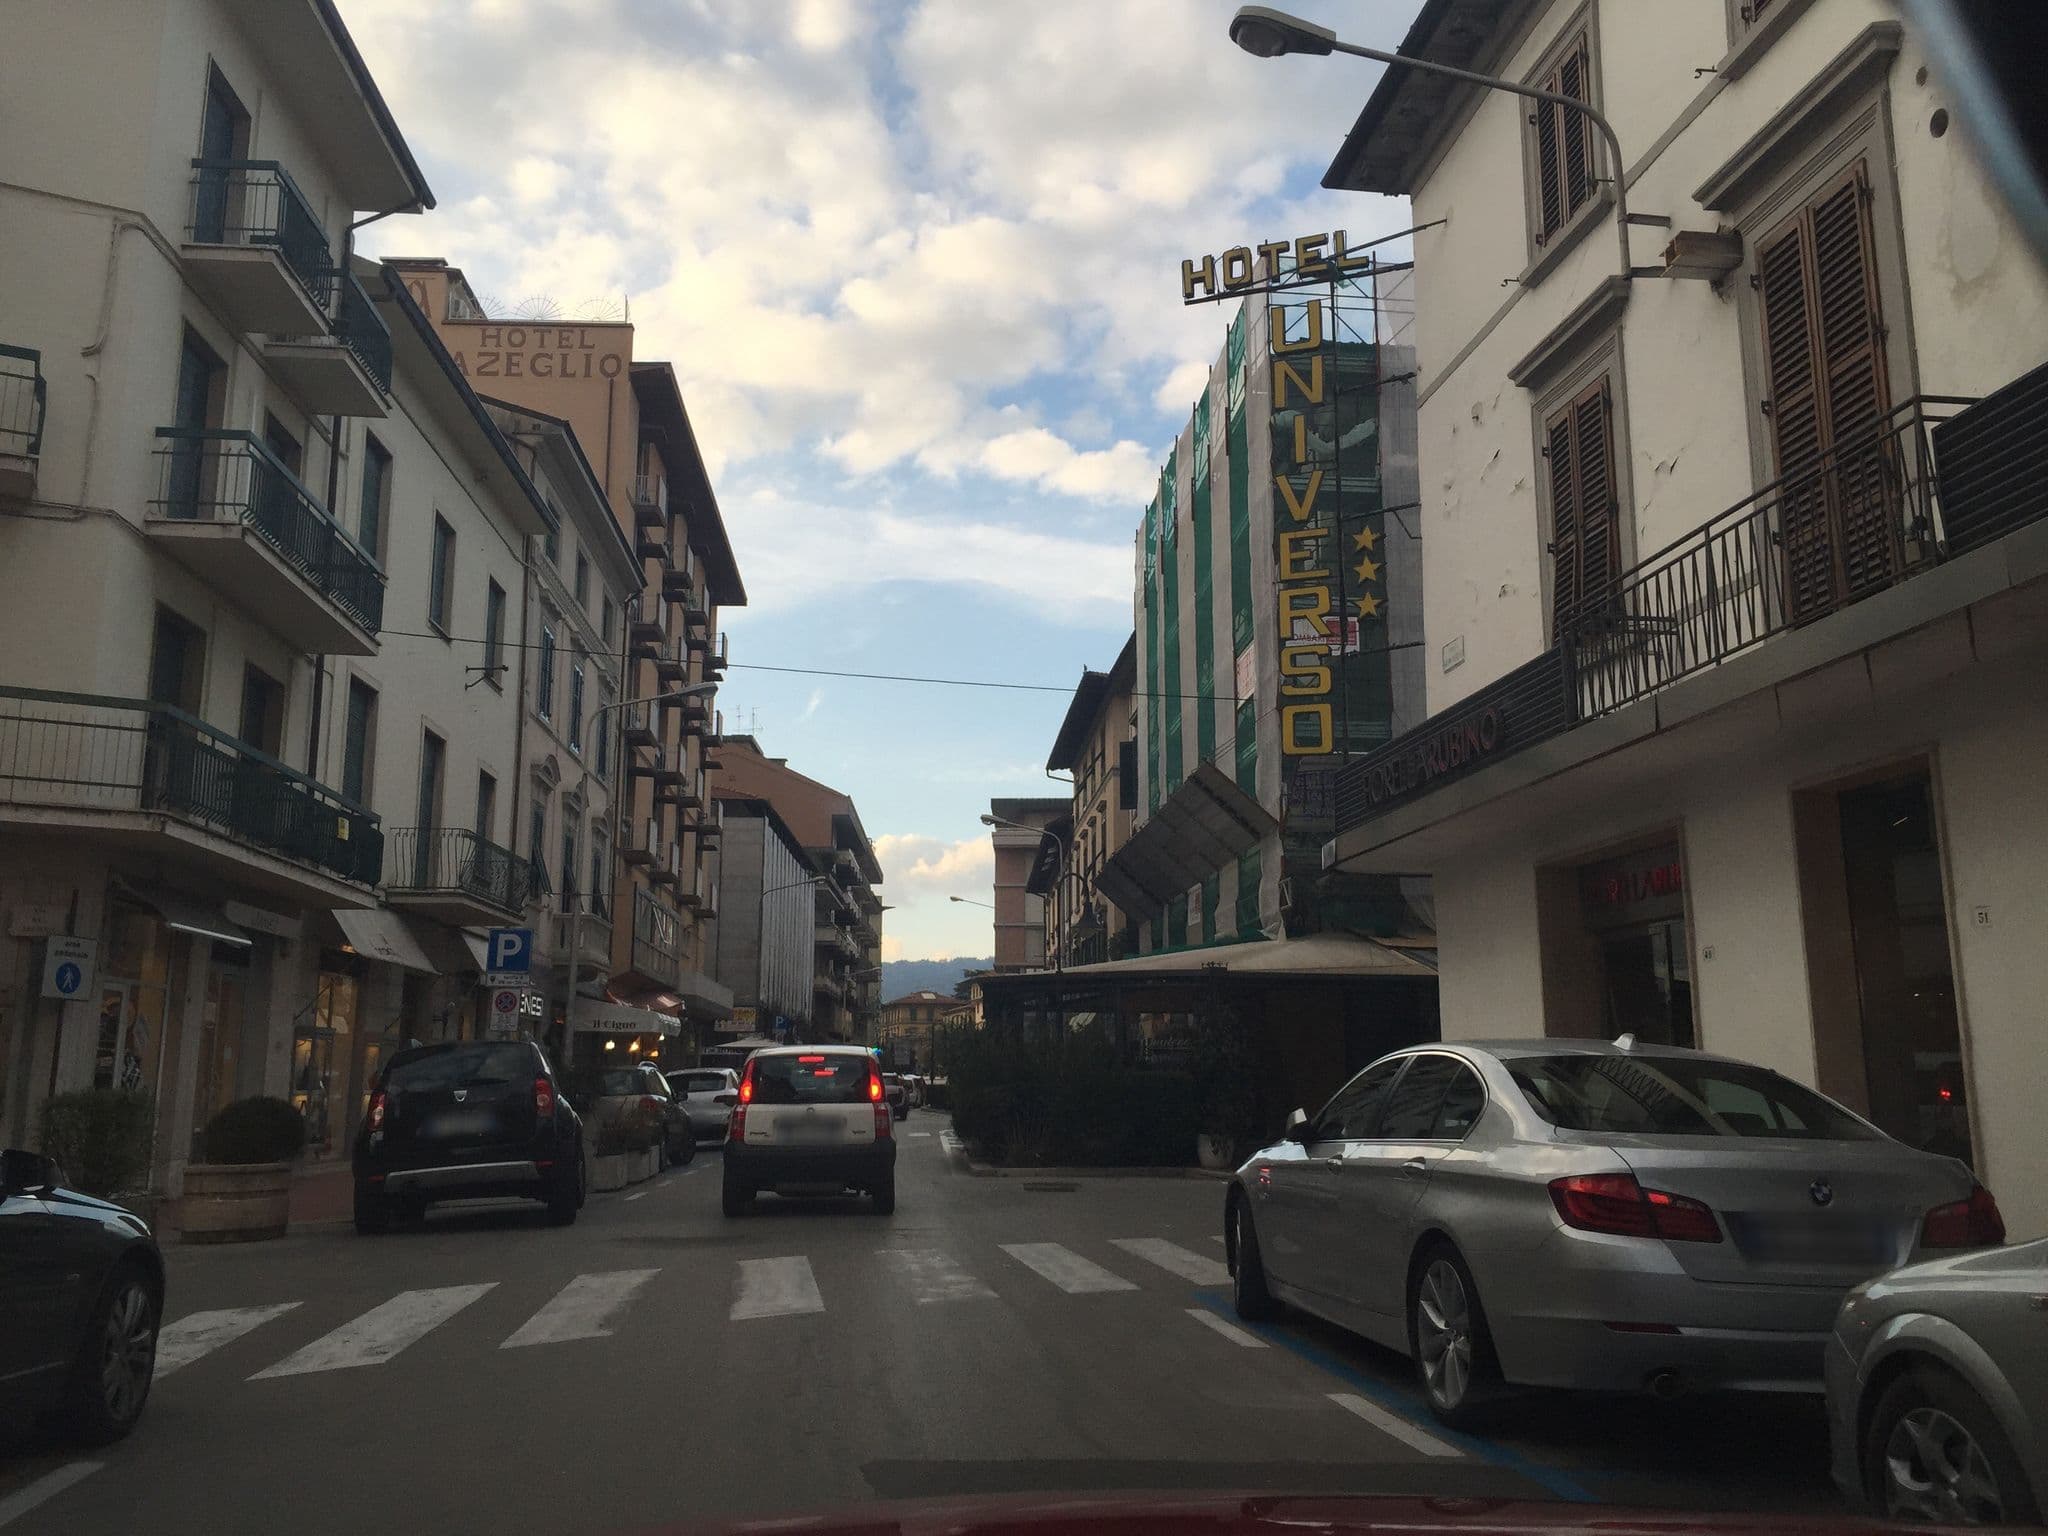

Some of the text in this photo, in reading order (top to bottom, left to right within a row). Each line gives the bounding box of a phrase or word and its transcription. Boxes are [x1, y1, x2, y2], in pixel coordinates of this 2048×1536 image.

[1182, 229, 1370, 299] HOTEL
[480, 327, 596, 350] HOTEL
[1270, 299, 1333, 756] UNIVERSO
[496, 933, 523, 968] P
[603, 1019, 636, 1031] Cigno
